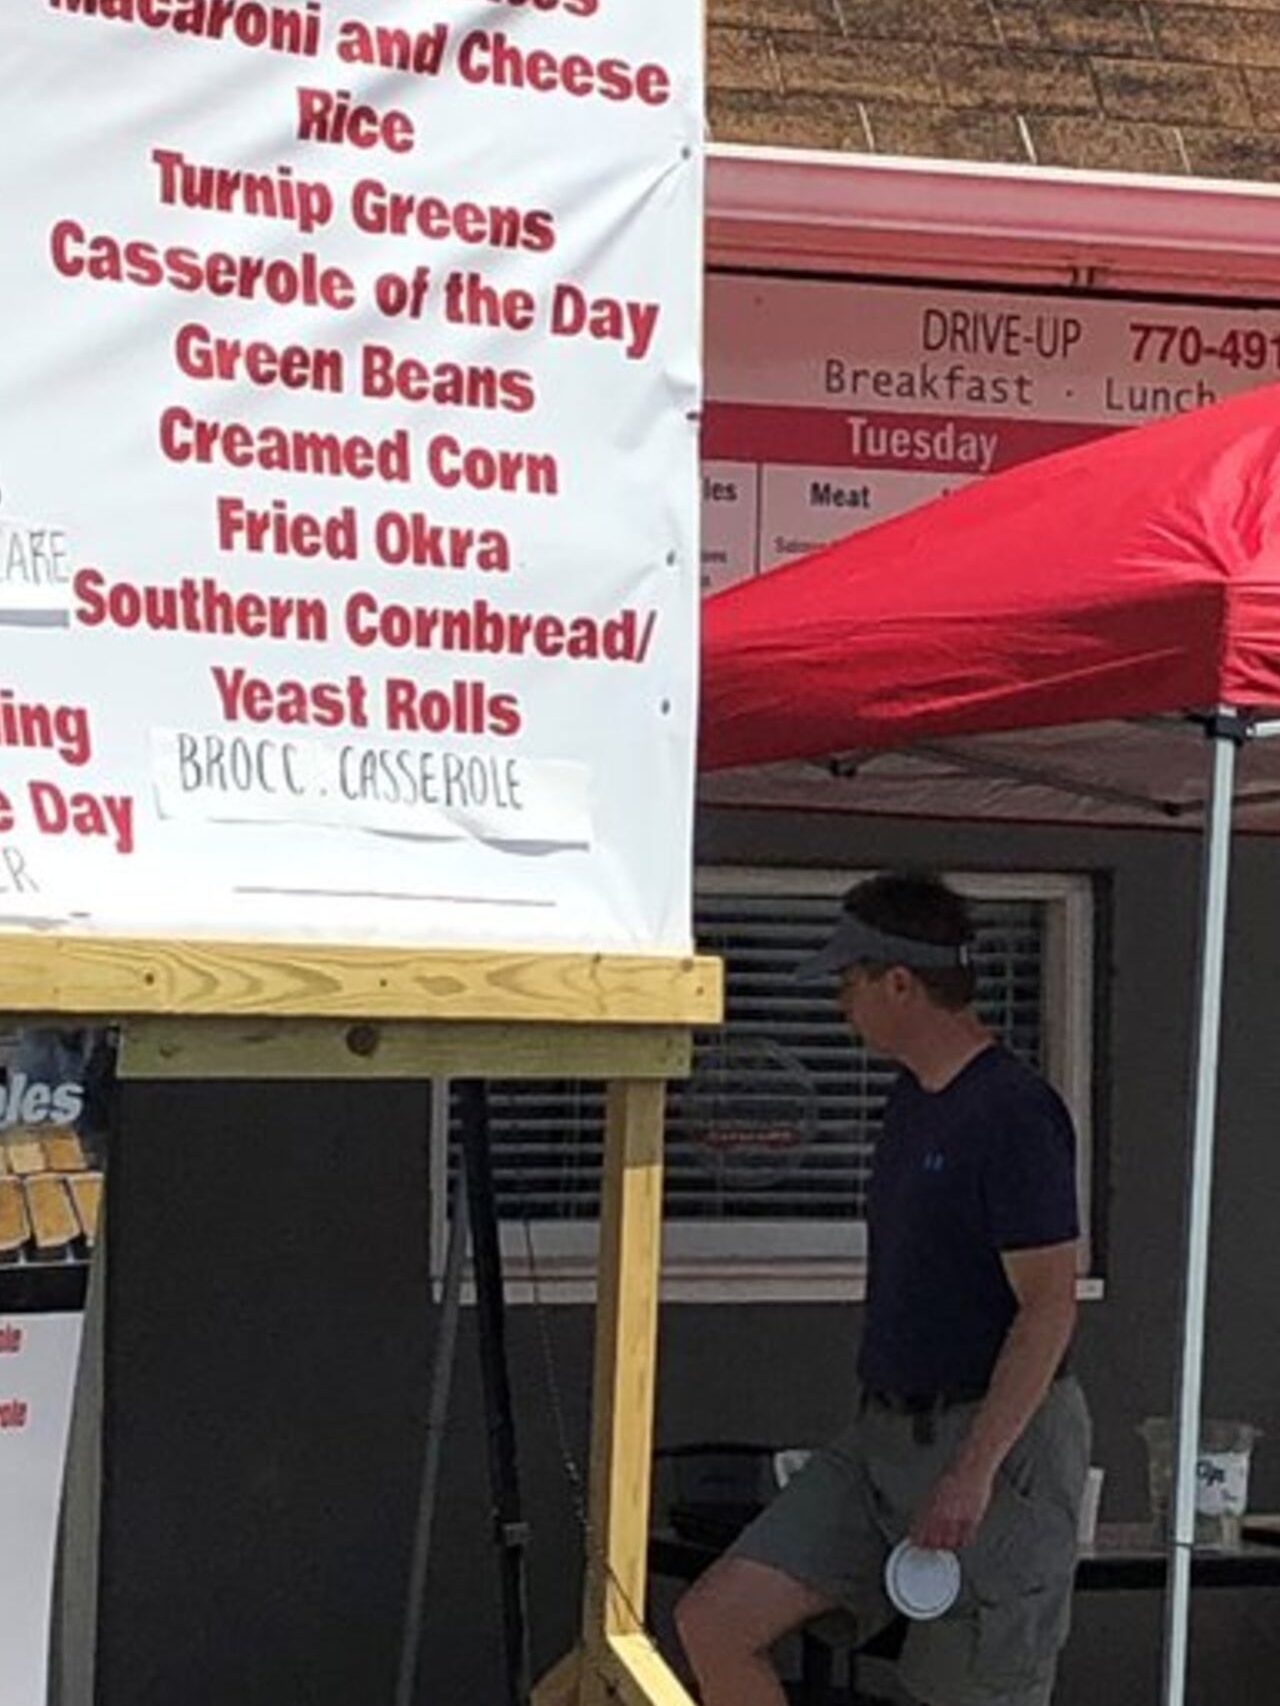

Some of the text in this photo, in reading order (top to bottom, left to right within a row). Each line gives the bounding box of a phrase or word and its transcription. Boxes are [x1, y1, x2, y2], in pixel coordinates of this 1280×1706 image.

[338, 11, 446, 75] and
[457, 30, 671, 106] Cheese
[297, 86, 417, 156] Rice
[153, 150, 556, 254] Turnip Greens
[49, 218, 661, 361] Casserole of the Day
[174, 324, 535, 414] Green Beans
[922, 308, 1083, 361] DRIVE-UP
[824, 359, 1217, 413] Breakfast Lunch
[159, 406, 558, 497] Creamed Corn
[846, 416, 1000, 472] Tuesday
[809, 482, 871, 508] Meat
[217, 496, 510, 573] Fried Okra
[72, 569, 659, 664] Southern Cornbread/
[213, 666, 522, 737] Yeast Rolls
[340, 745, 522, 810] CASSEROLE
[28, 780, 135, 854] Day
